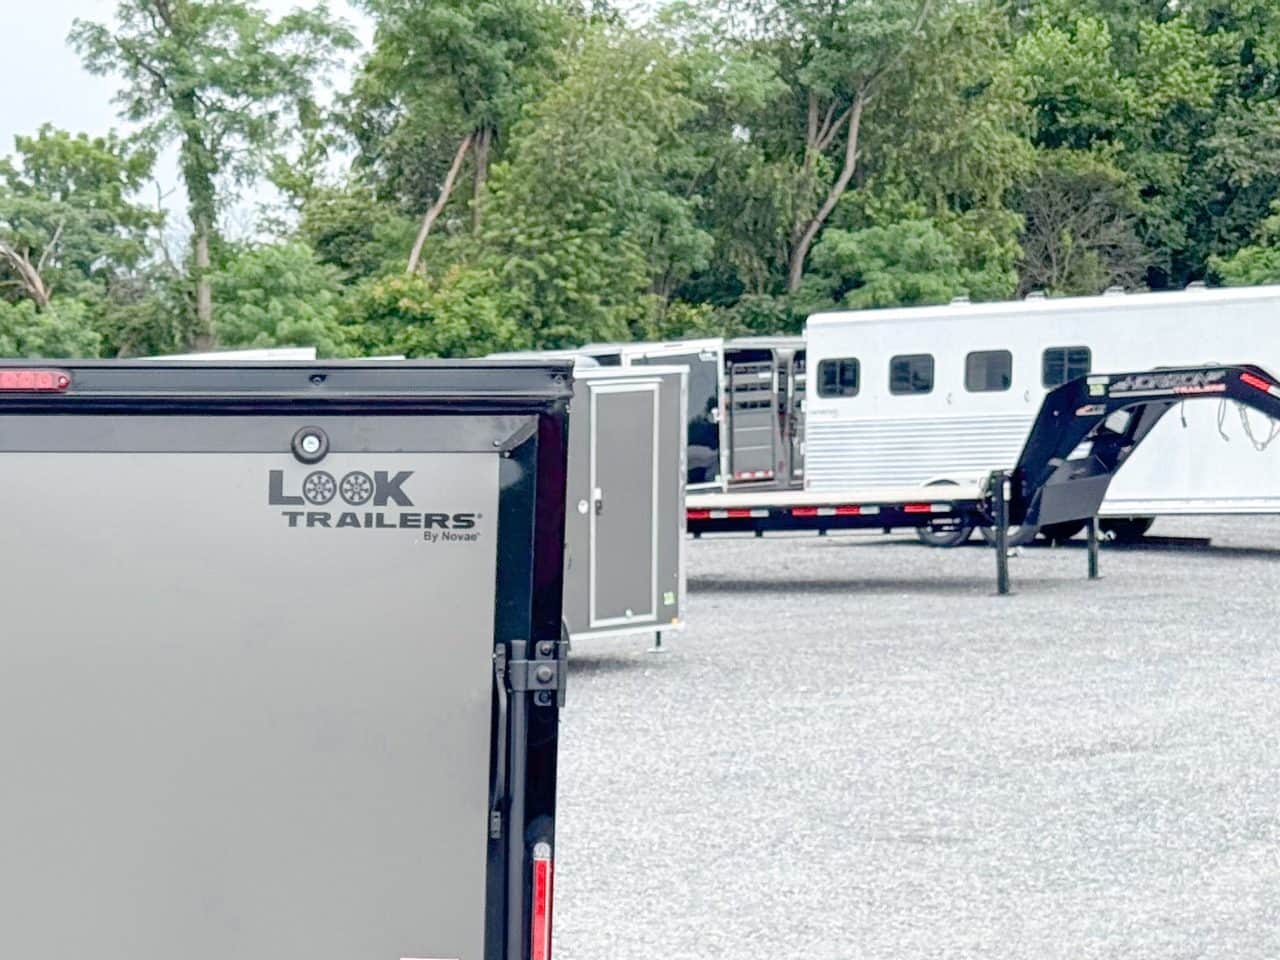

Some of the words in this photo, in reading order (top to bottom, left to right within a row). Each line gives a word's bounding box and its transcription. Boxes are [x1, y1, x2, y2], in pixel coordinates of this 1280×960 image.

[268, 470, 415, 506] LOOK
[282, 511, 475, 529] TRAILERS
[423, 531, 439, 543] By
